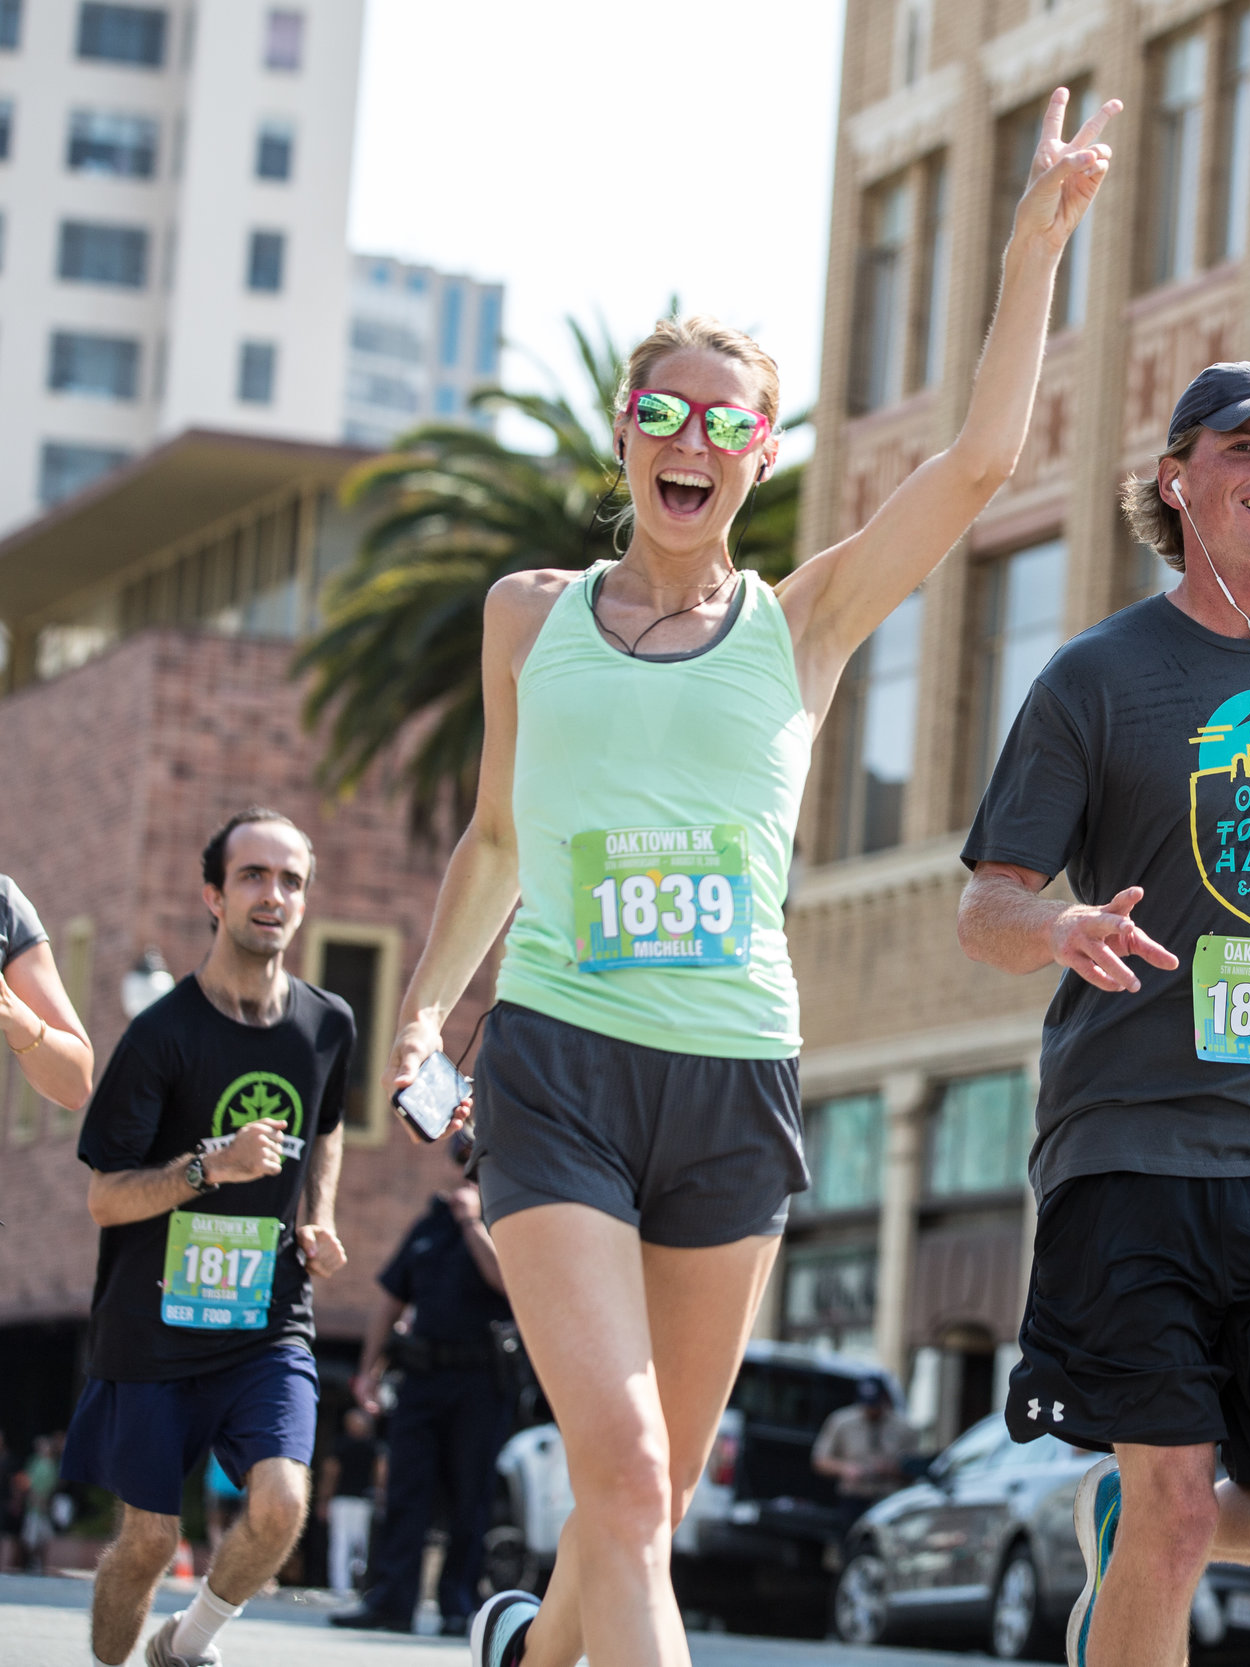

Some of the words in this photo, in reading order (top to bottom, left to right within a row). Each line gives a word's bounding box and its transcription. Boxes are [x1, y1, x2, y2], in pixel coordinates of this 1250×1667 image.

[606, 831, 687, 854] OAKTOWN
[692, 830, 714, 850] 5K
[591, 873, 734, 939] 1839
[633, 940, 704, 958] MICHELLE
[192, 1216, 242, 1233] OAKTOWN
[245, 1220, 259, 1234] 5K
[184, 1244, 263, 1289] 1817
[166, 1305, 194, 1321] BEER
[202, 1307, 232, 1324] FOOD
